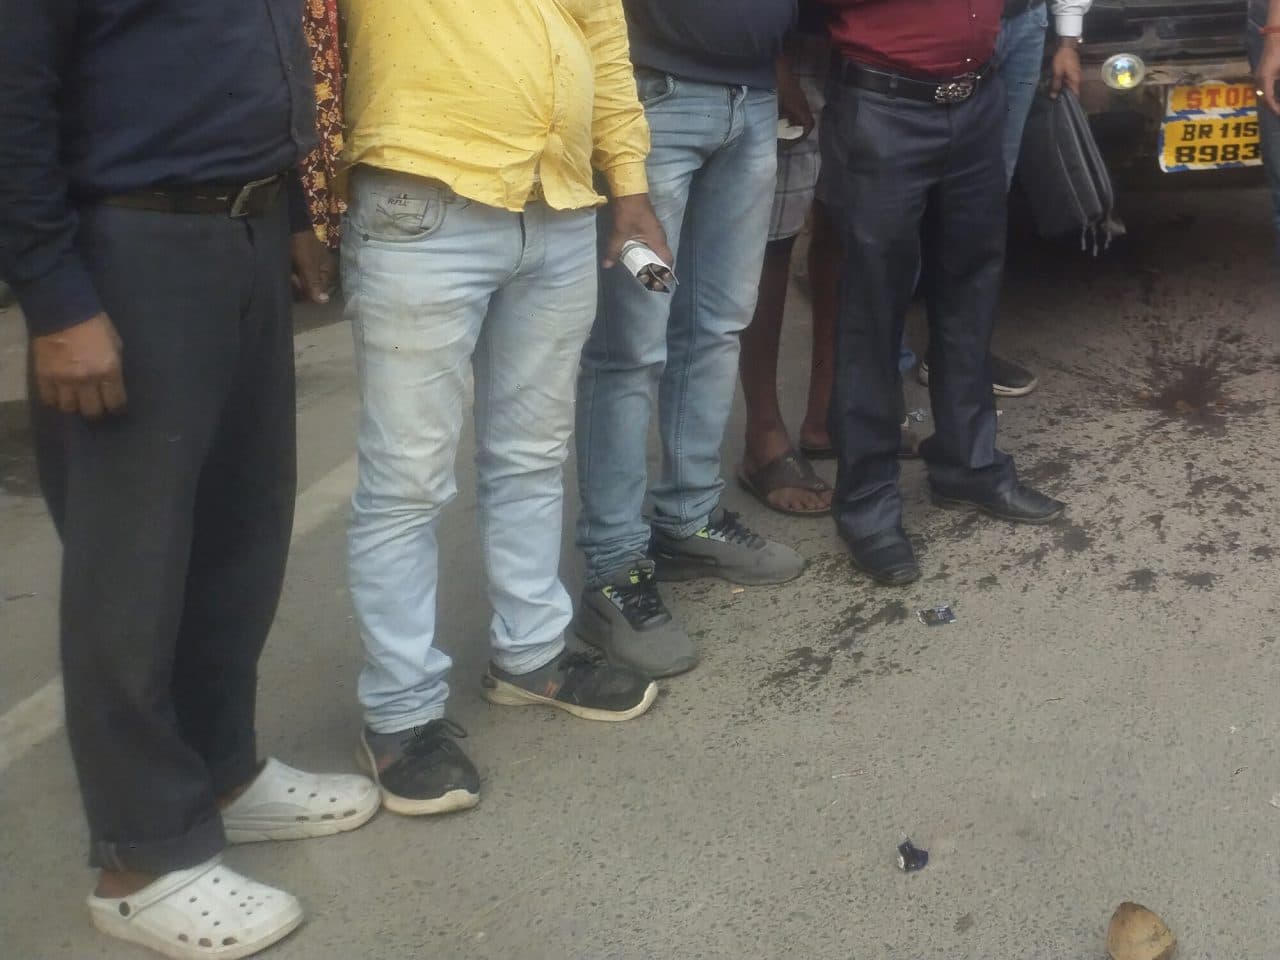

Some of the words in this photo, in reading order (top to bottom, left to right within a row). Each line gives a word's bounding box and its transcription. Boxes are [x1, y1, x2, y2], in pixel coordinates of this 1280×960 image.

[1186, 86, 1257, 109] STOP
[1181, 123, 1213, 141] BR
[1175, 142, 1260, 163] 8983
